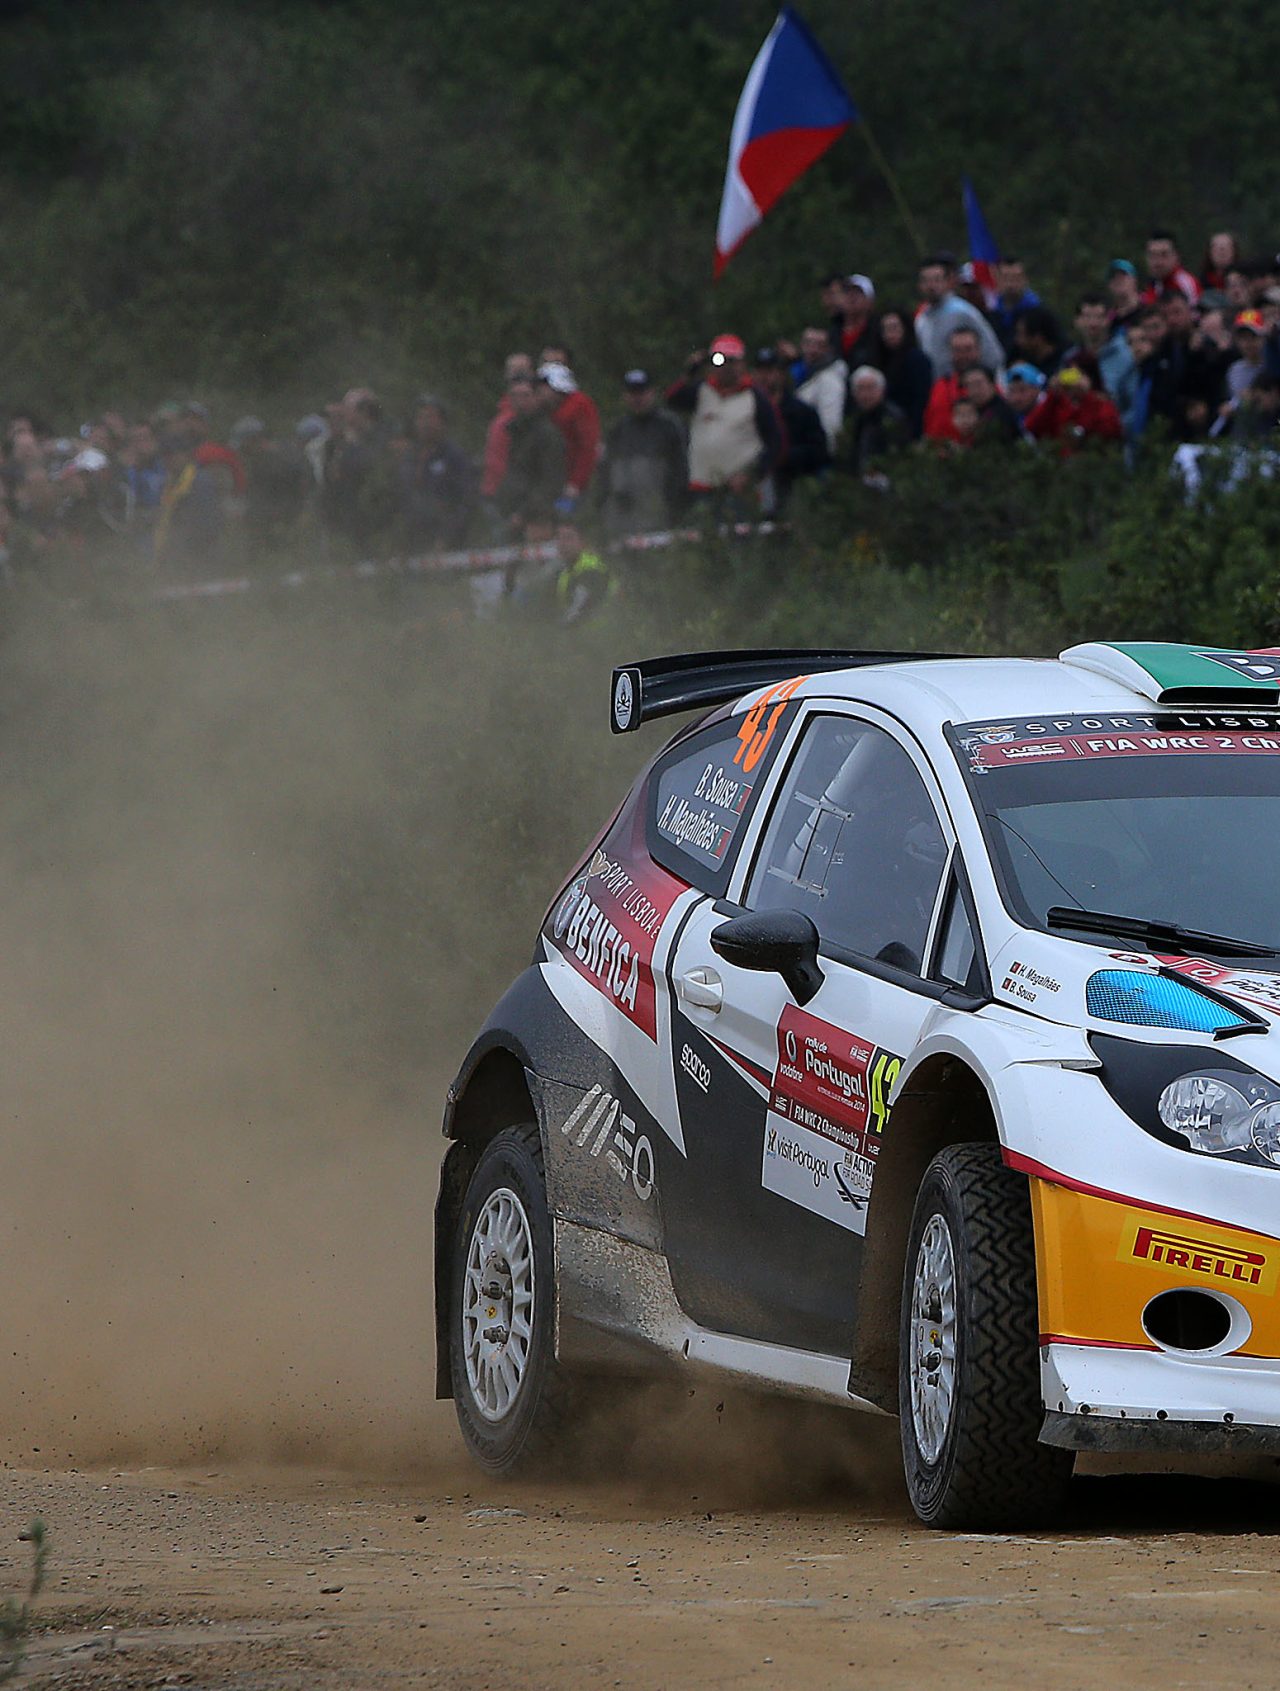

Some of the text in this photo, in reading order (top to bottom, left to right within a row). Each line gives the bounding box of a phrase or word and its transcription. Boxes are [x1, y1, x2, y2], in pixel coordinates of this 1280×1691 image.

[733, 675, 810, 772] 43
[1025, 716, 1154, 734] SPORT
[1087, 738, 1137, 753] FIA
[1141, 737, 1209, 750] WRC
[1214, 737, 1236, 749] 2
[694, 763, 739, 809] B. Sousa
[657, 795, 677, 829] H.
[600, 862, 633, 899] SPORT
[622, 888, 661, 932] LISBOA
[566, 894, 639, 1012] BENFICA
[1017, 964, 1028, 978] H.
[1008, 981, 1037, 1003] B. Sousa
[680, 1043, 711, 1090] sparco
[780, 1063, 804, 1083] vodafone
[794, 1105, 859, 1152] FIA WRC 2 Championship
[778, 1136, 829, 1188] visit Portugal
[853, 1154, 874, 1178] ACTIO
[1132, 1226, 1266, 1284] PIRELLI
